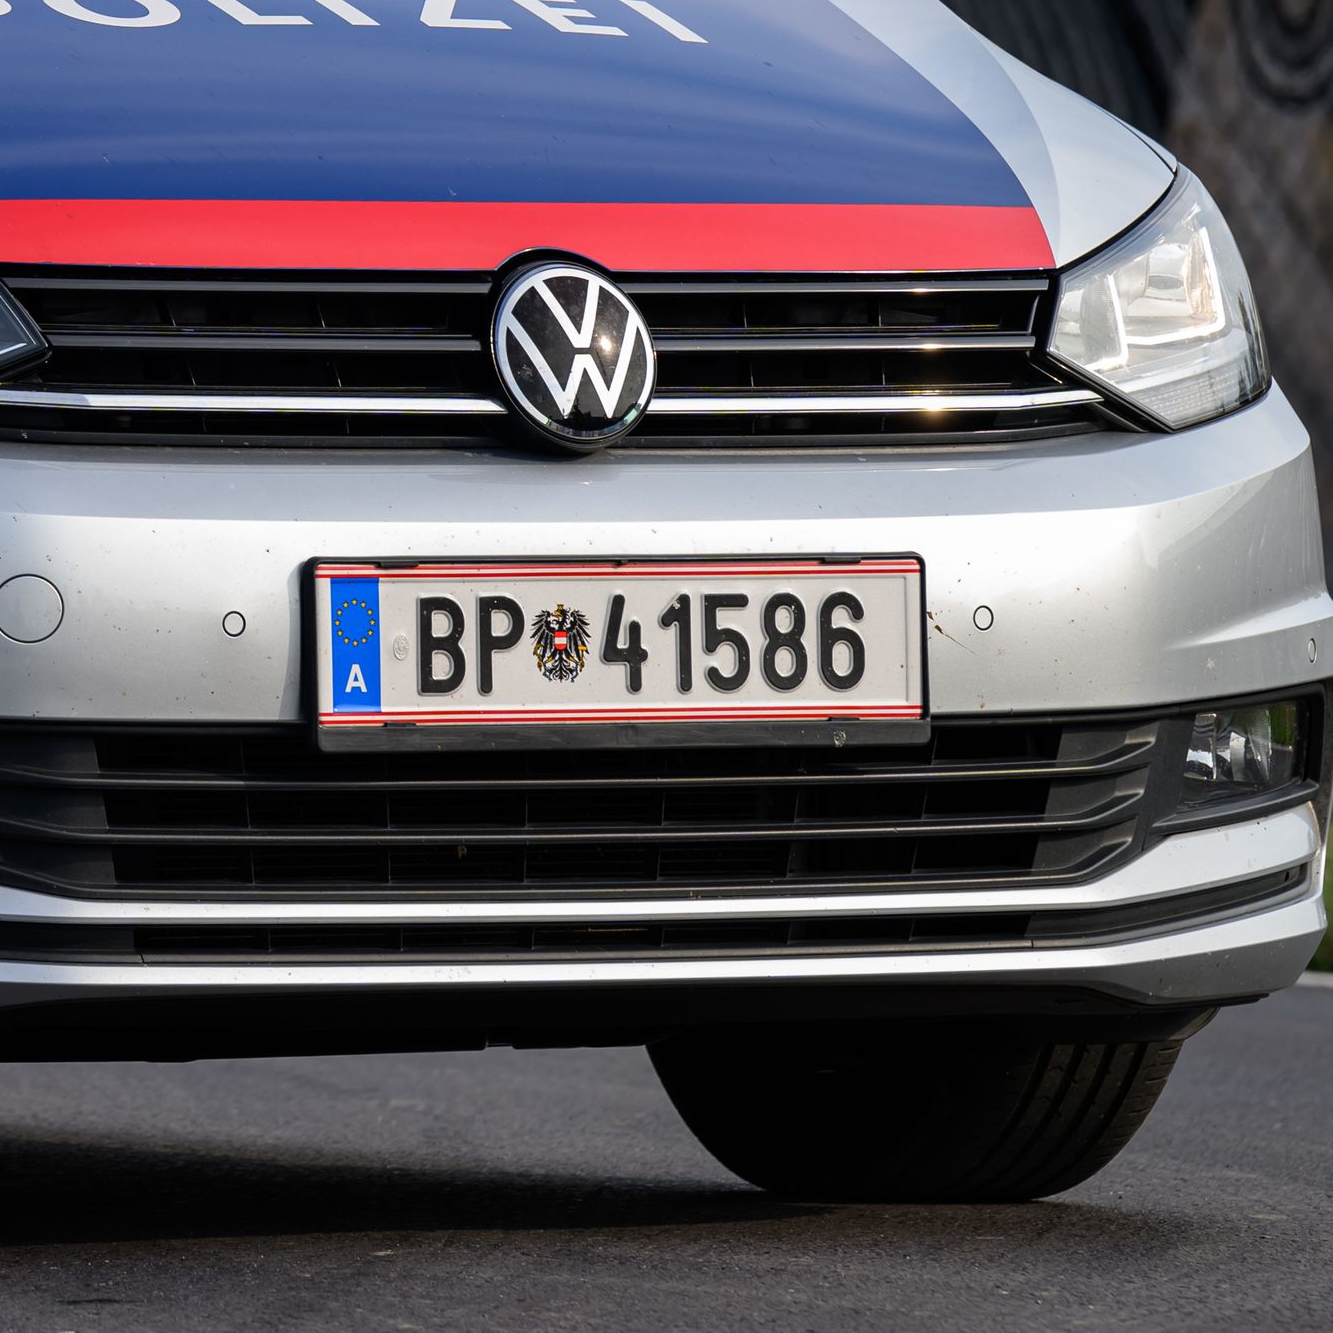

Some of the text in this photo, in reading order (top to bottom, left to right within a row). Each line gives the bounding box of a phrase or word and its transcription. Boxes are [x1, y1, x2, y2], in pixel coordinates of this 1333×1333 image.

[419, 592, 866, 696] BP 41586
[344, 664, 368, 694] A
